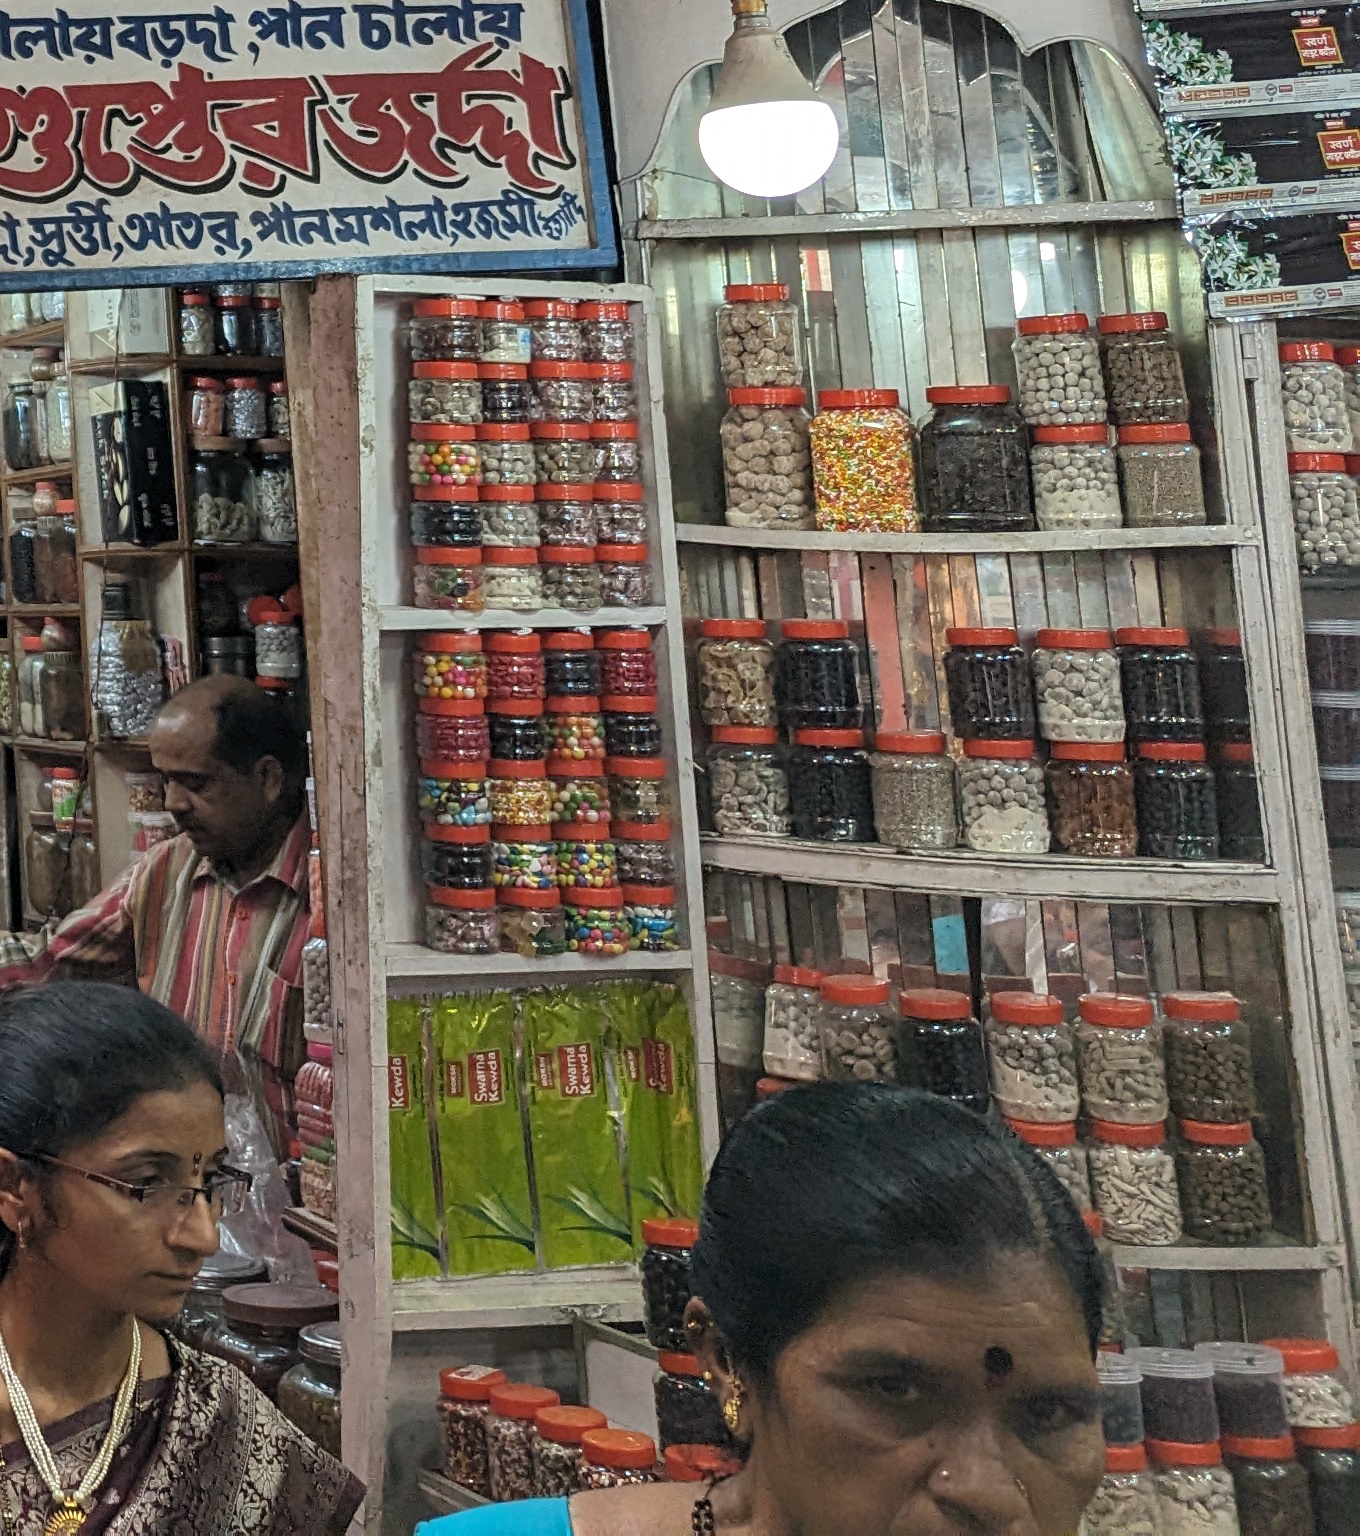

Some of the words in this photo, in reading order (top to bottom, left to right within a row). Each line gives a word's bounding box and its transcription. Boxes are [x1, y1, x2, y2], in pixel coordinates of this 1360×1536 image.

[391, 1056, 405, 1108] Kewda
[475, 1053, 488, 1103] Swarna
[488, 1051, 500, 1102] Kewda
[565, 1046, 579, 1095] Swarna
[580, 1044, 592, 1095] Kewda
